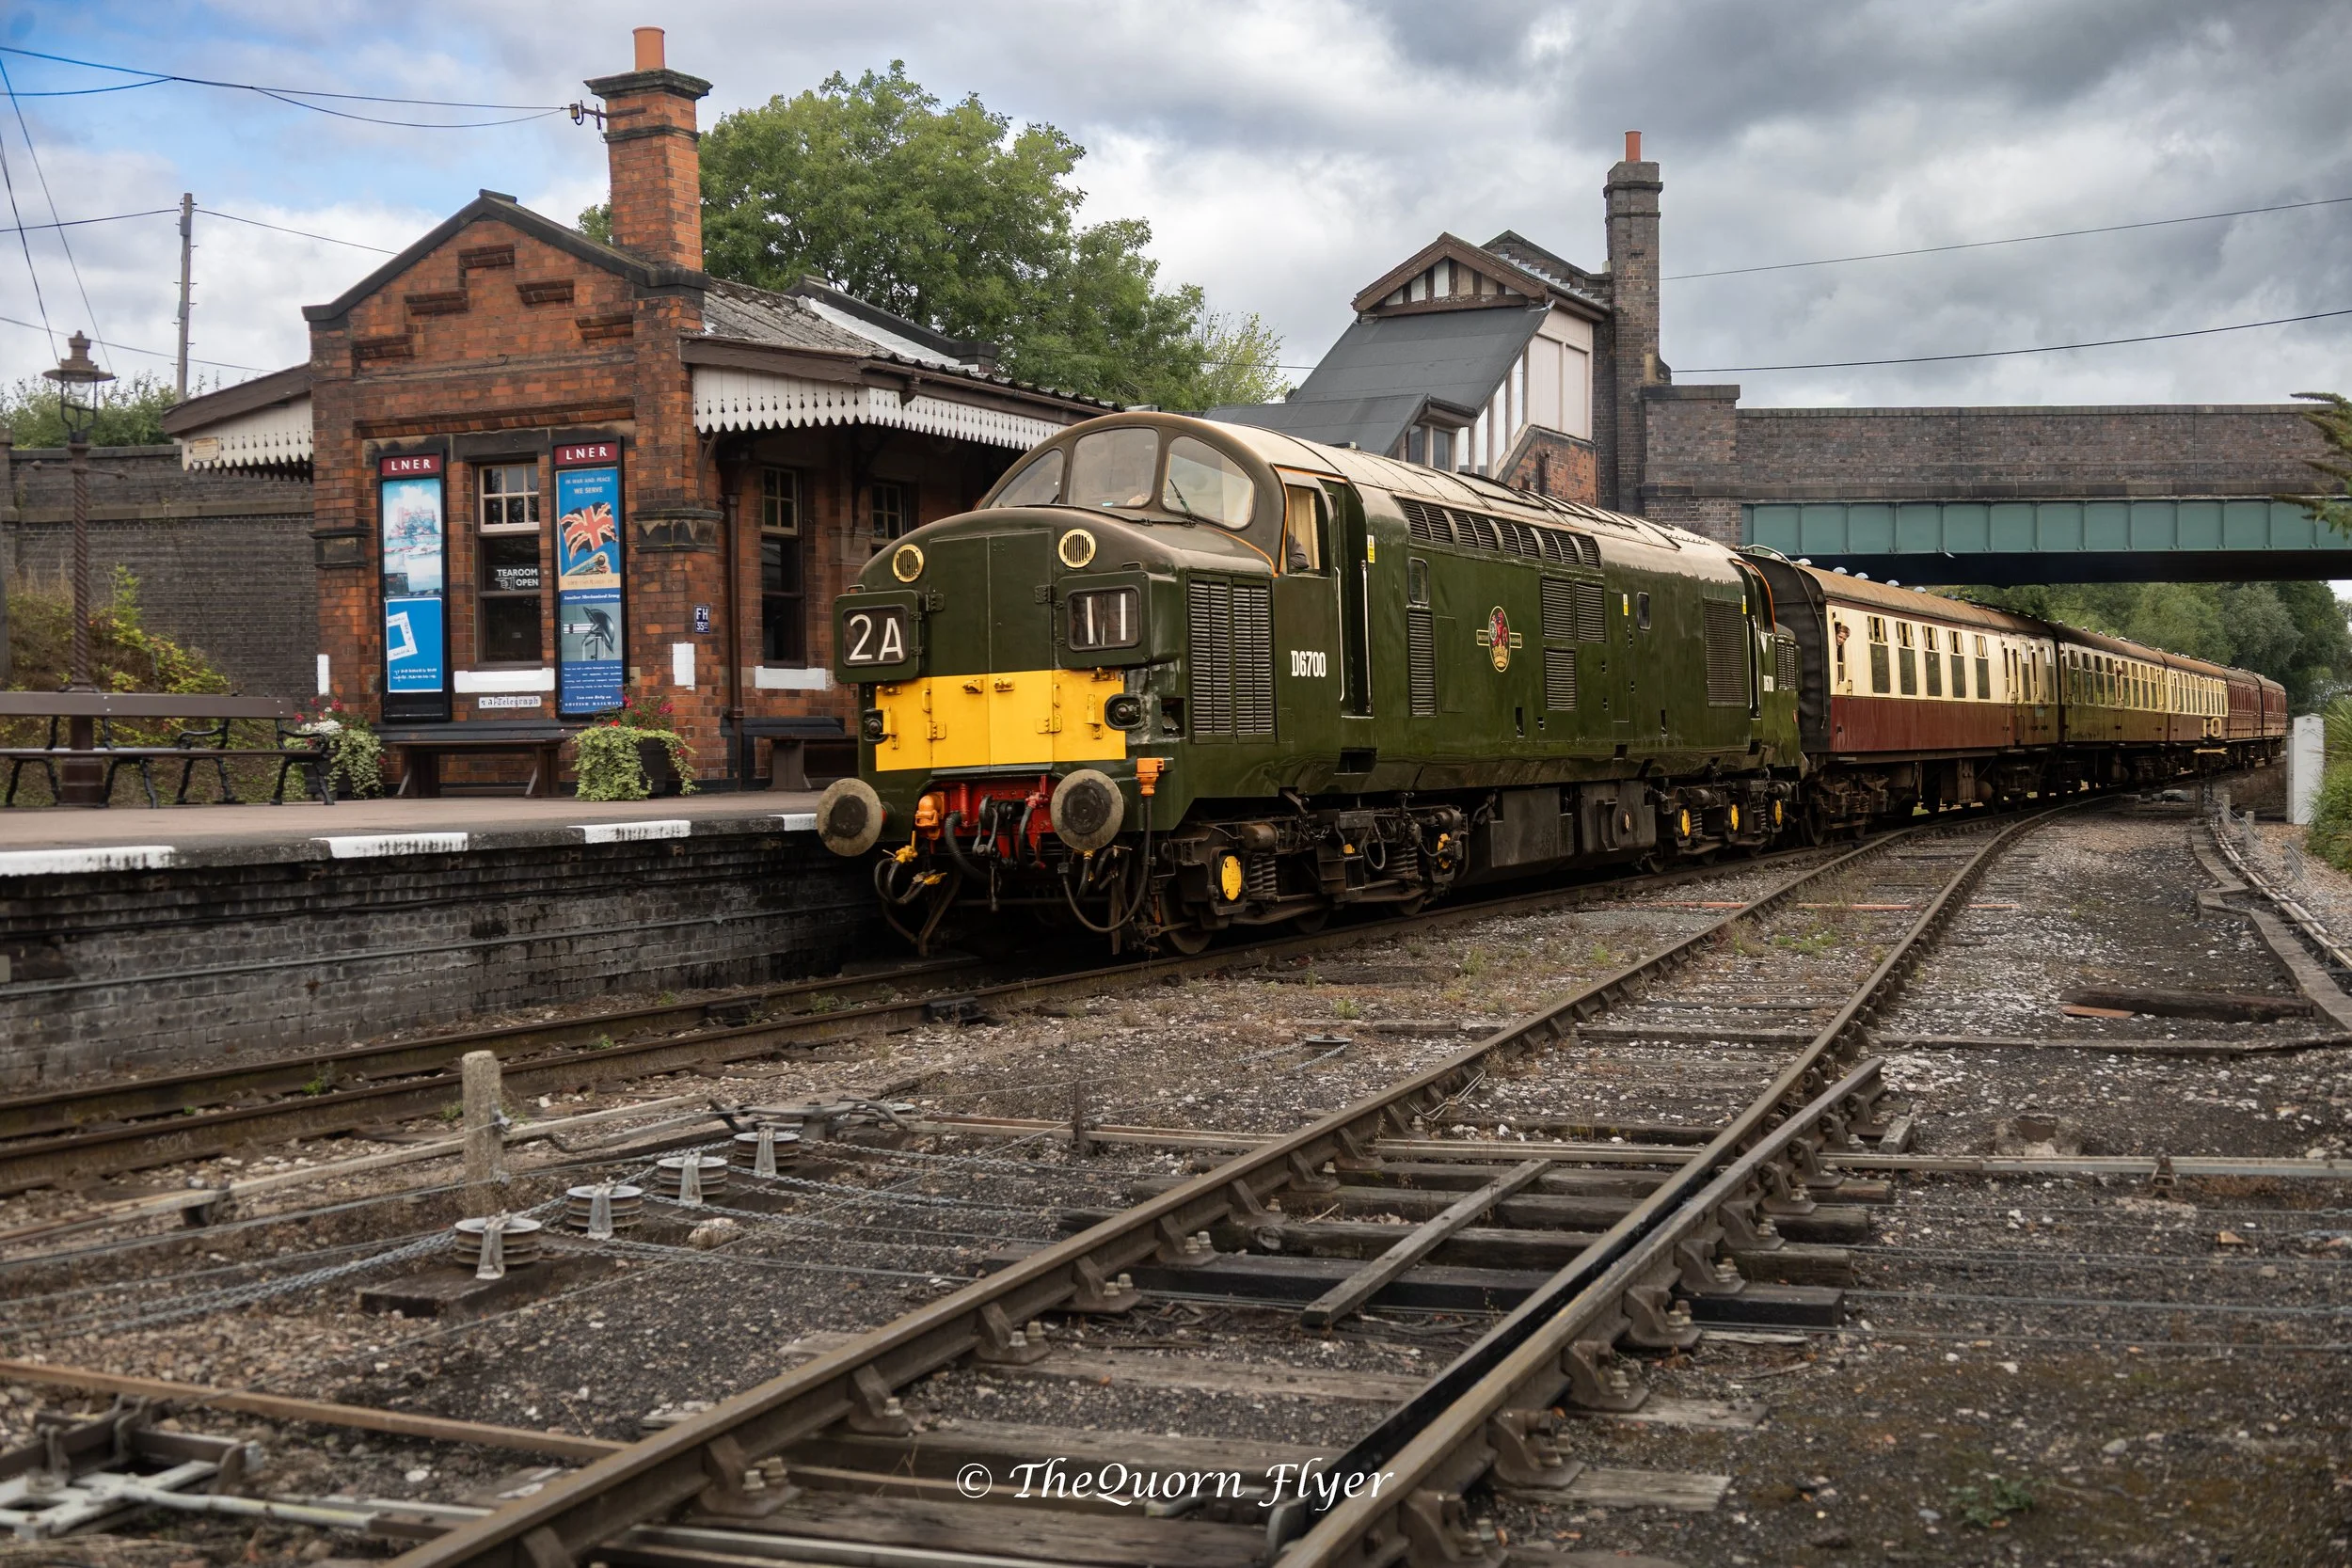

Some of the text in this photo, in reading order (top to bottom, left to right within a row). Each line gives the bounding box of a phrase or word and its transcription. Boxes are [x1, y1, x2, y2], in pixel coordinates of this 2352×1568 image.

[565, 446, 608, 461] LNER
[390, 458, 432, 471] LNER
[585, 486, 603, 495] SERVE
[497, 568, 538, 577] TEAROOM
[516, 578, 539, 587] OPEN
[696, 608, 708, 620] FH
[1087, 593, 1127, 644] 11
[849, 613, 904, 661] 2A
[1291, 650, 1327, 677] D6700
[2202, 717, 2222, 737] 10
